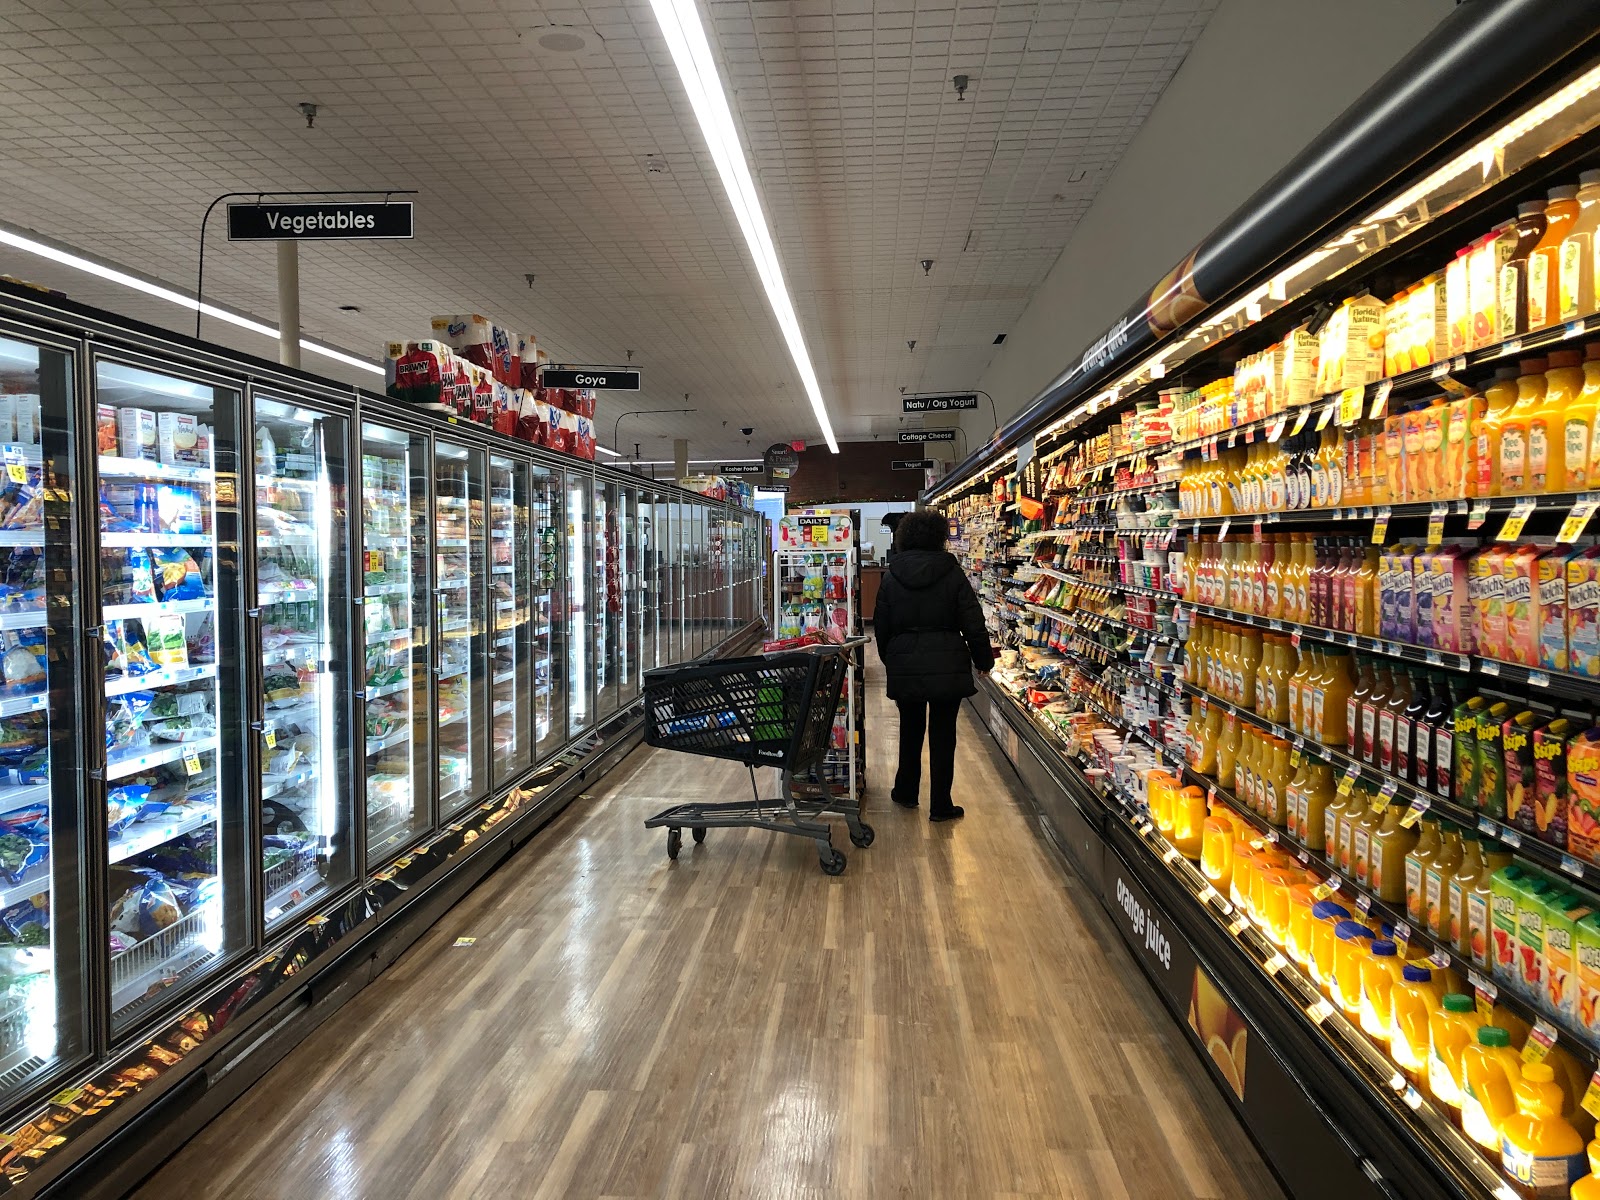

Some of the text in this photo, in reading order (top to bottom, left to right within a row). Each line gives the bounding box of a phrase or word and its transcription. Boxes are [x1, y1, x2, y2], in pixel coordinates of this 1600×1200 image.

[266, 210, 376, 234] Vegetables
[1353, 316, 1380, 324] Natural
[399, 361, 428, 373] BRAWNY
[575, 374, 606, 387] Goya
[906, 401, 925, 409] Natu
[932, 399, 948, 409] Org
[949, 398, 975, 408] Yogurt
[901, 433, 927, 441] Cottage
[799, 517, 830, 525] DAILY'S
[1117, 877, 1171, 971] orange juice
